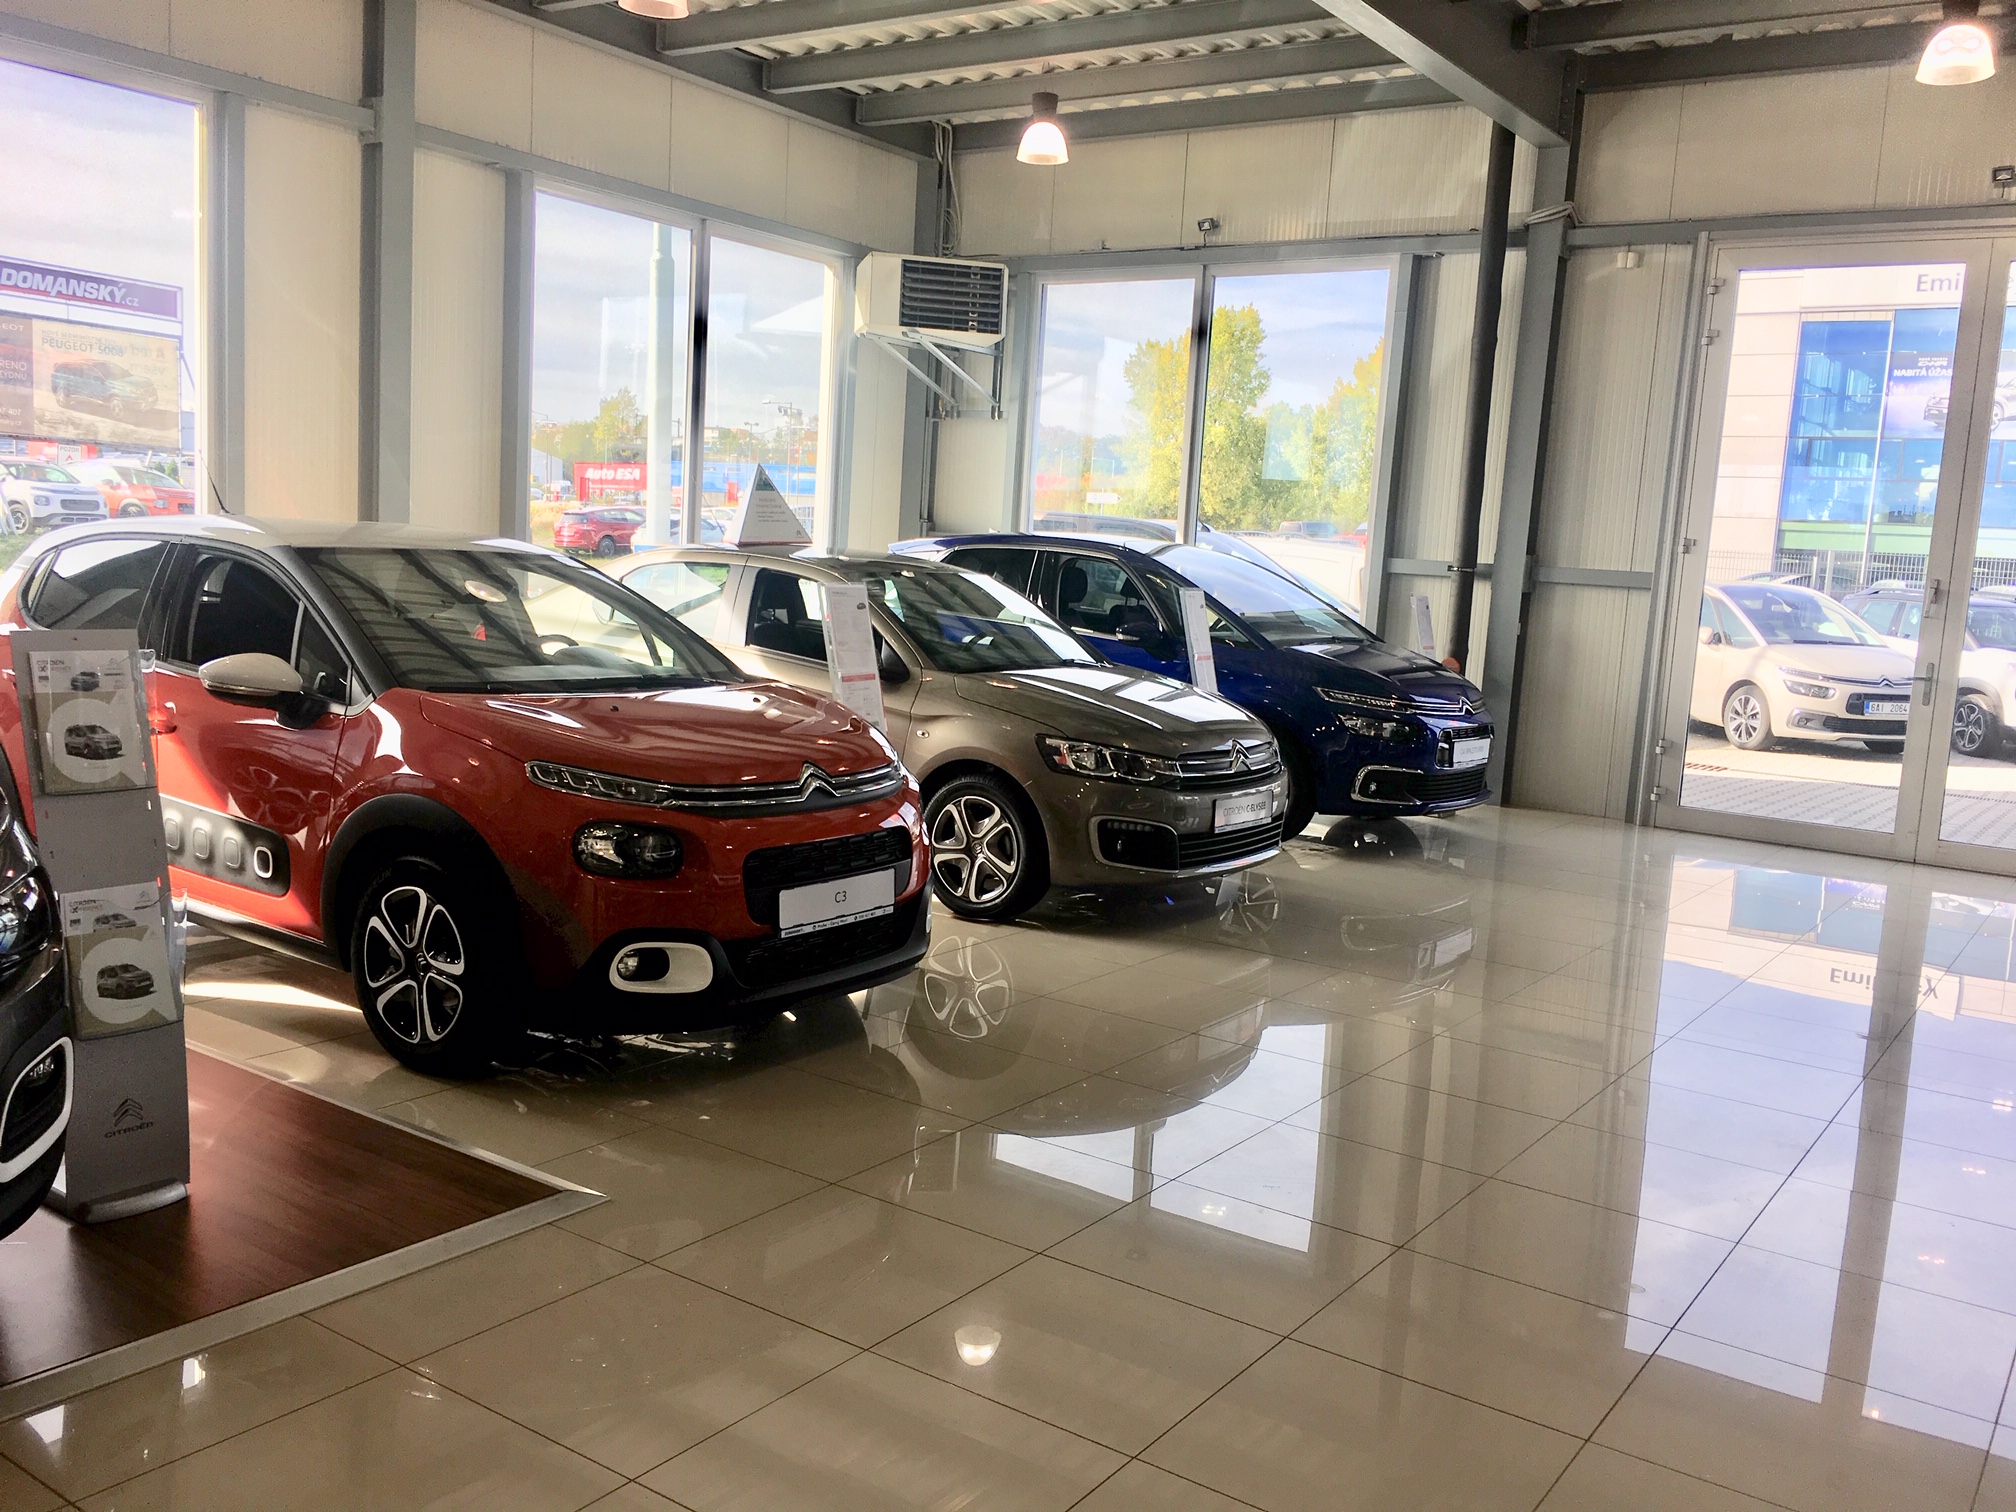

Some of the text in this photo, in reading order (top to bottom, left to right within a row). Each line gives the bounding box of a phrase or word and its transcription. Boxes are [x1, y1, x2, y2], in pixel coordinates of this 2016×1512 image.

[41, 337, 94, 353] PEUGEOT
[1894, 368, 1927, 376] NABITÁ
[585, 468, 640, 480] Auto ESA
[1890, 704, 1908, 713] 2064
[834, 890, 848, 904] C3
